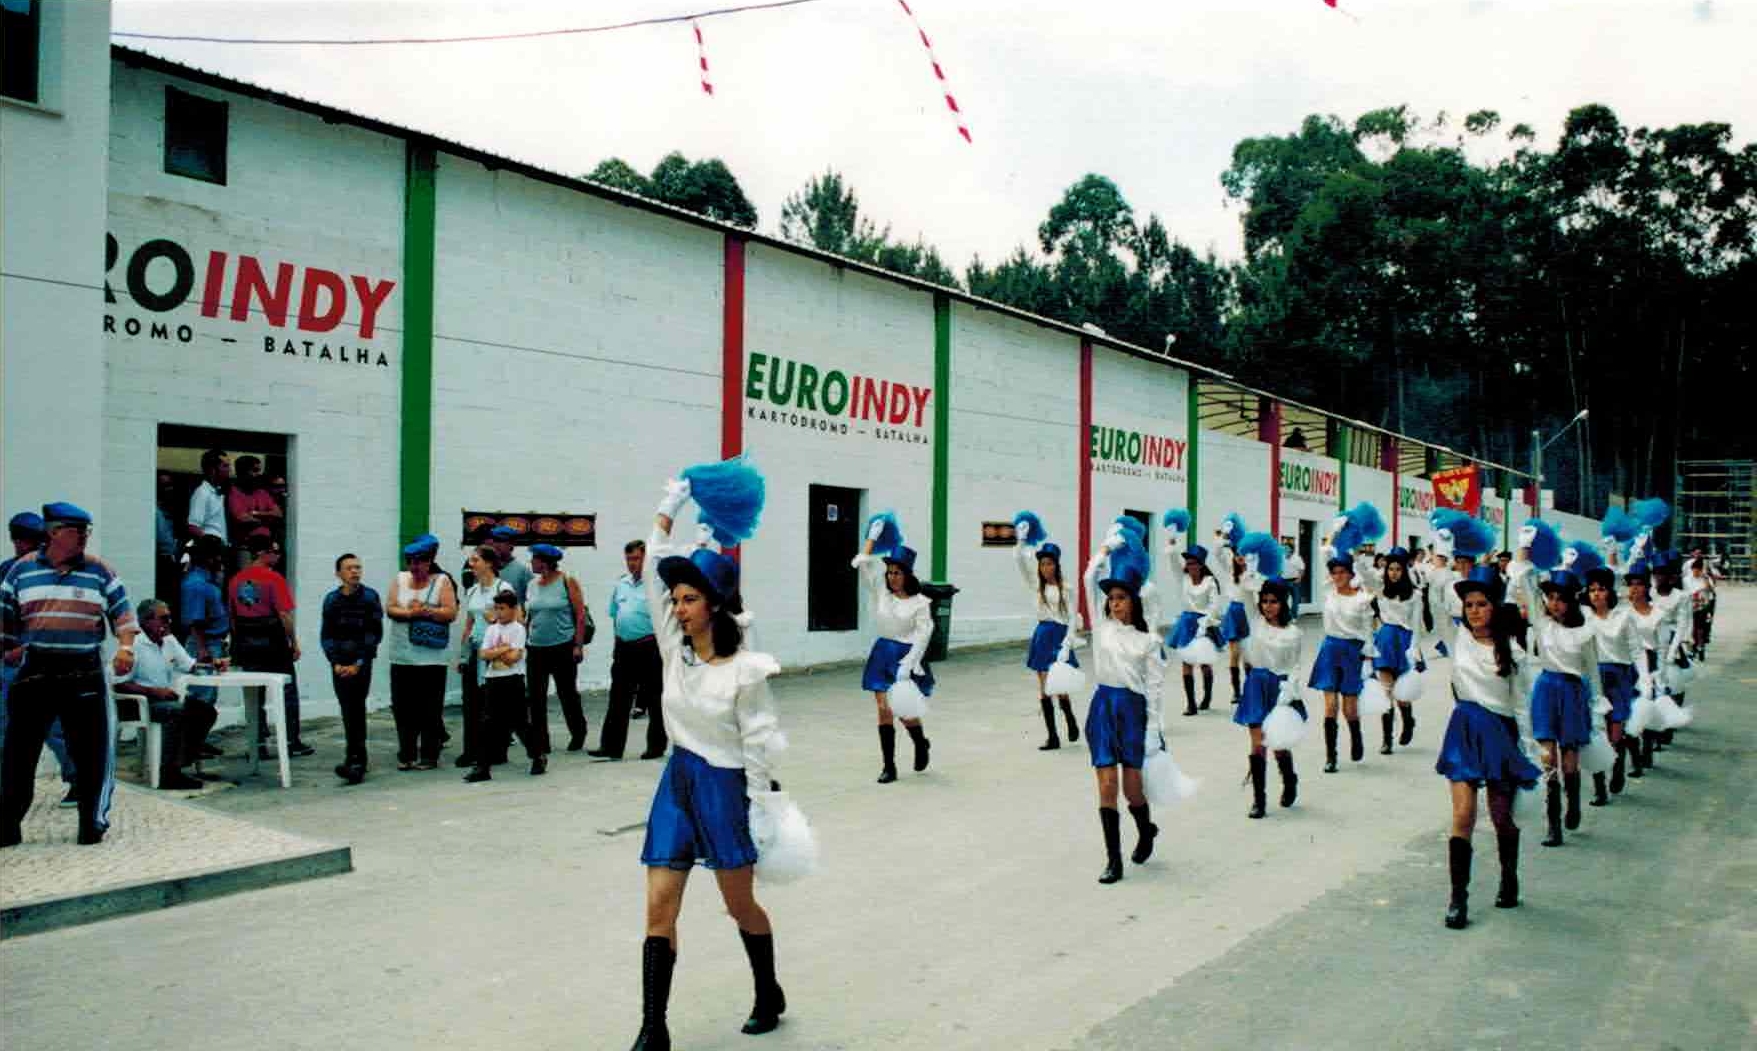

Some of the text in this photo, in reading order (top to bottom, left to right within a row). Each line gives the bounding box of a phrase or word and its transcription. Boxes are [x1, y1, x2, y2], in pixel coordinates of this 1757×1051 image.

[104, 231, 396, 339] OINDY
[263, 336, 389, 366] BATALHA
[746, 352, 931, 427] EUROINDY
[1090, 425, 1186, 470] EUROINDY
